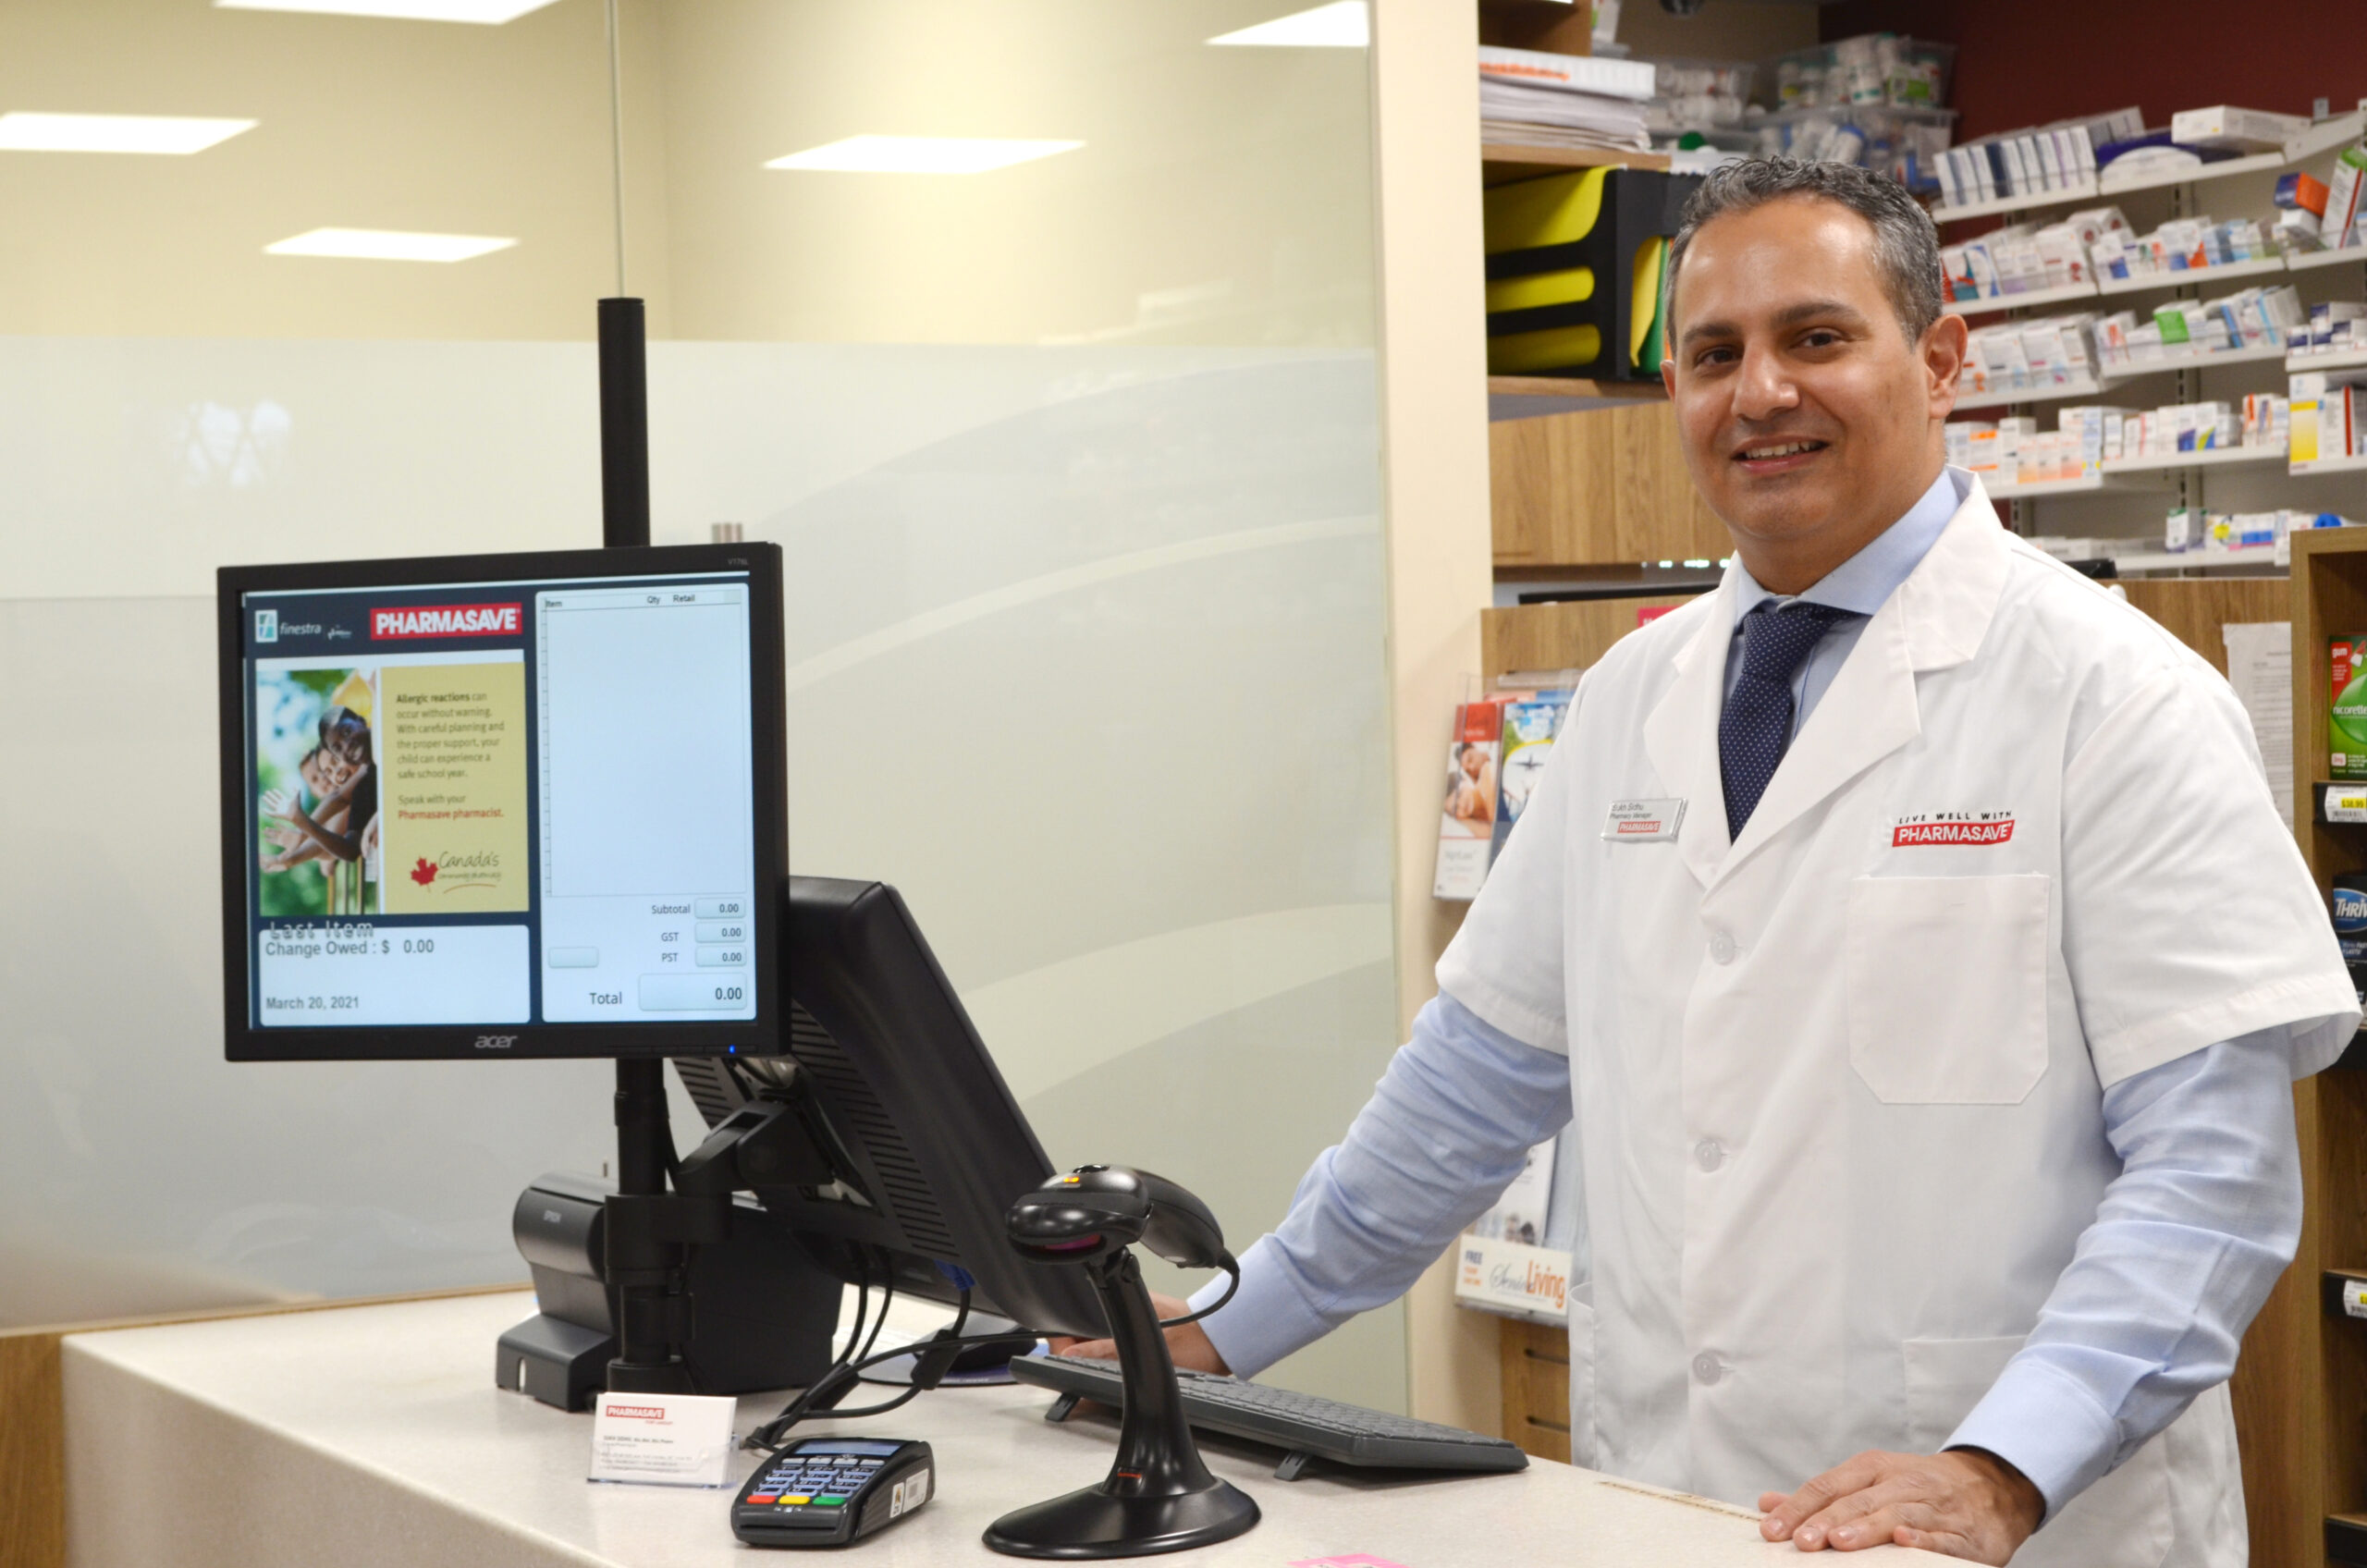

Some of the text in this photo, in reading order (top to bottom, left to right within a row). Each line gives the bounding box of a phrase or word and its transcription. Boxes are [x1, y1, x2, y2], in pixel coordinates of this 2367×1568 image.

[646, 595, 661, 605] Qty
[673, 594, 695, 603] Retail
[376, 608, 517, 635] PHARMASAVE
[279, 622, 322, 635] finestra
[2332, 647, 2348, 658] gum
[396, 692, 487, 704] Allergic reactions can
[422, 709, 454, 718] without
[455, 707, 492, 719] warning.
[397, 721, 505, 734] With careful planning and
[397, 739, 500, 750] the proper support, your
[397, 753, 491, 765] child can experience a
[398, 769, 468, 779] safe school year.
[398, 794, 466, 805] Speak with your
[398, 808, 504, 821] Pharmasave pharmacist.
[1899, 811, 2012, 825] LIVE WELL WITH
[1898, 823, 2009, 843] PHARMASAVE
[439, 851, 499, 869] Canada's
[652, 903, 739, 915] Subtotal 0.00
[270, 921, 374, 939] Last Item
[661, 927, 742, 942] GST 0.00
[265, 942, 321, 959] Change
[325, 940, 368, 955] Owed
[381, 939, 390, 955] $
[403, 939, 435, 953] 0.00
[661, 952, 742, 962] PST 0.00
[589, 987, 742, 1005] Total 0.00
[265, 996, 359, 1011] March 20, 2021
[474, 1035, 518, 1048] acer
[1466, 1251, 1483, 1265] FREE
[1526, 1260, 1566, 1309] Living
[607, 1407, 664, 1419] PHARMASAVE
